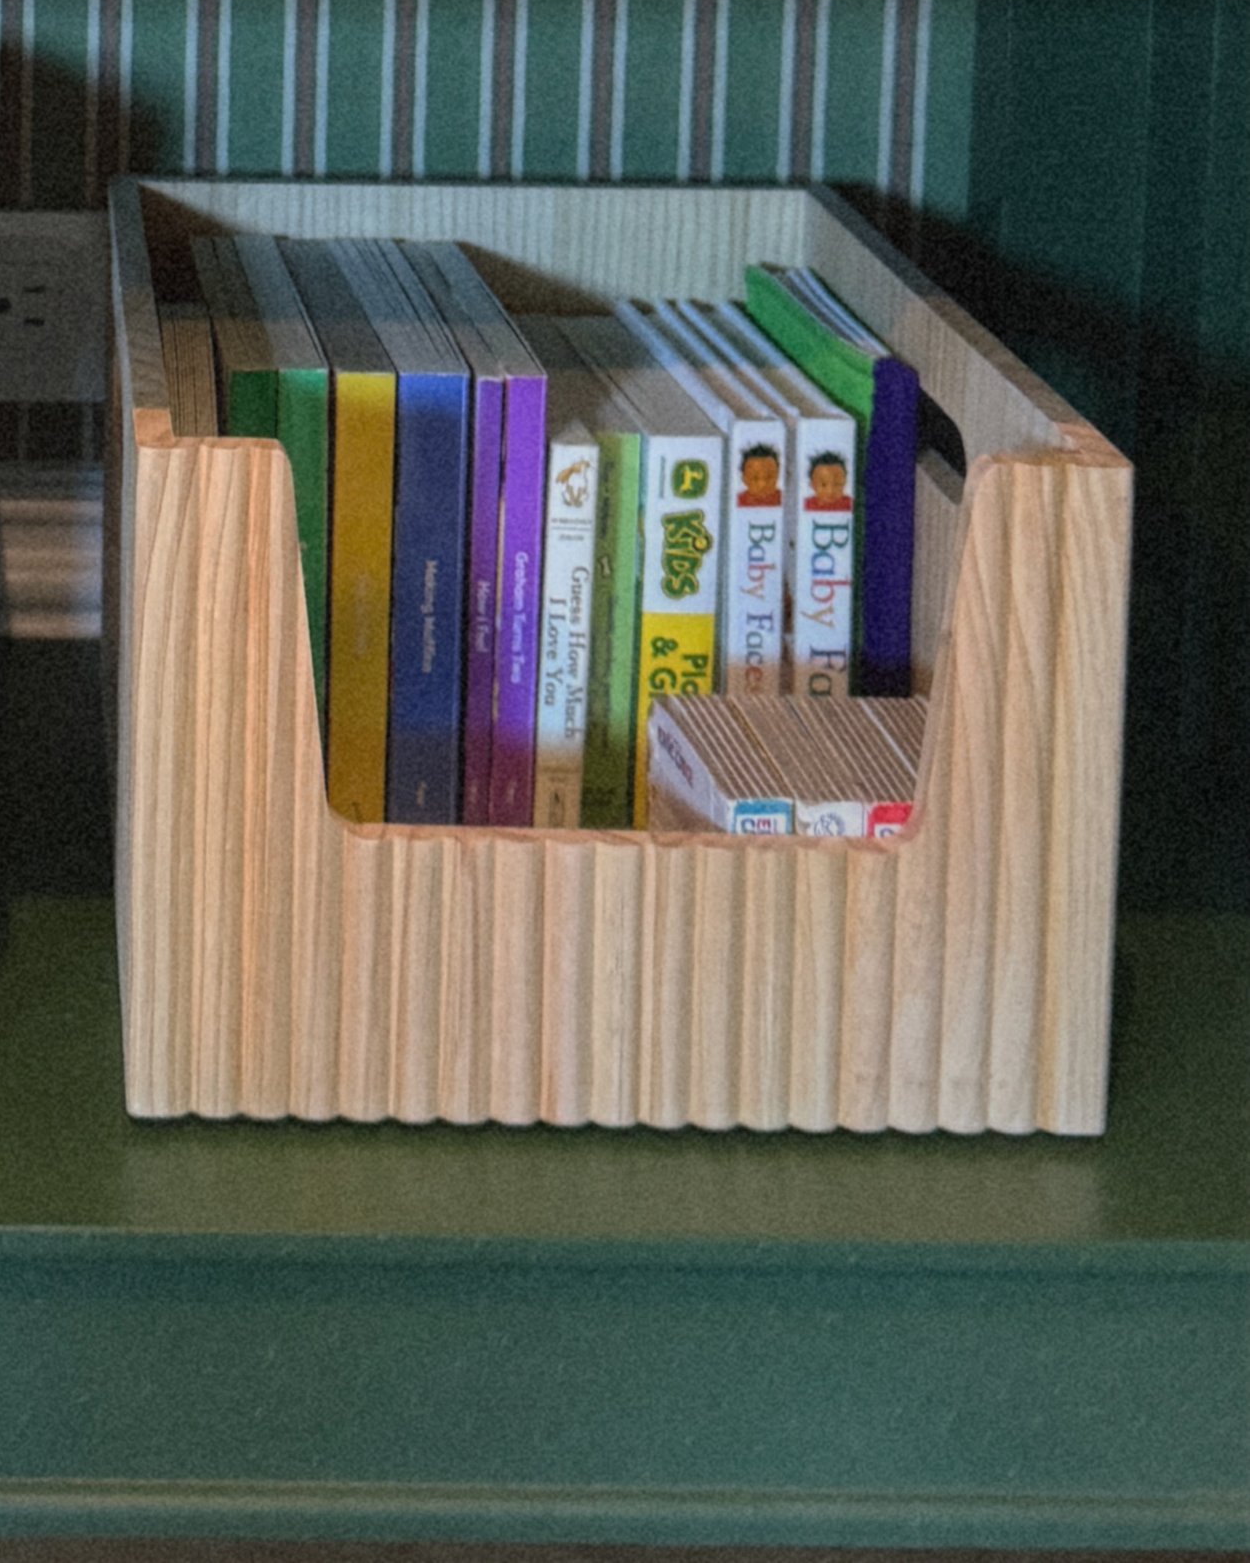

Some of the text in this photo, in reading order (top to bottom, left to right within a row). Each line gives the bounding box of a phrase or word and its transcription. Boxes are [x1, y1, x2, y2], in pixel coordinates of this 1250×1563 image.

[741, 521, 774, 600] Baby
[801, 521, 852, 628] Baby
[547, 612, 565, 659] Love
[566, 566, 590, 738] Guess How Much
[544, 668, 562, 706] You
